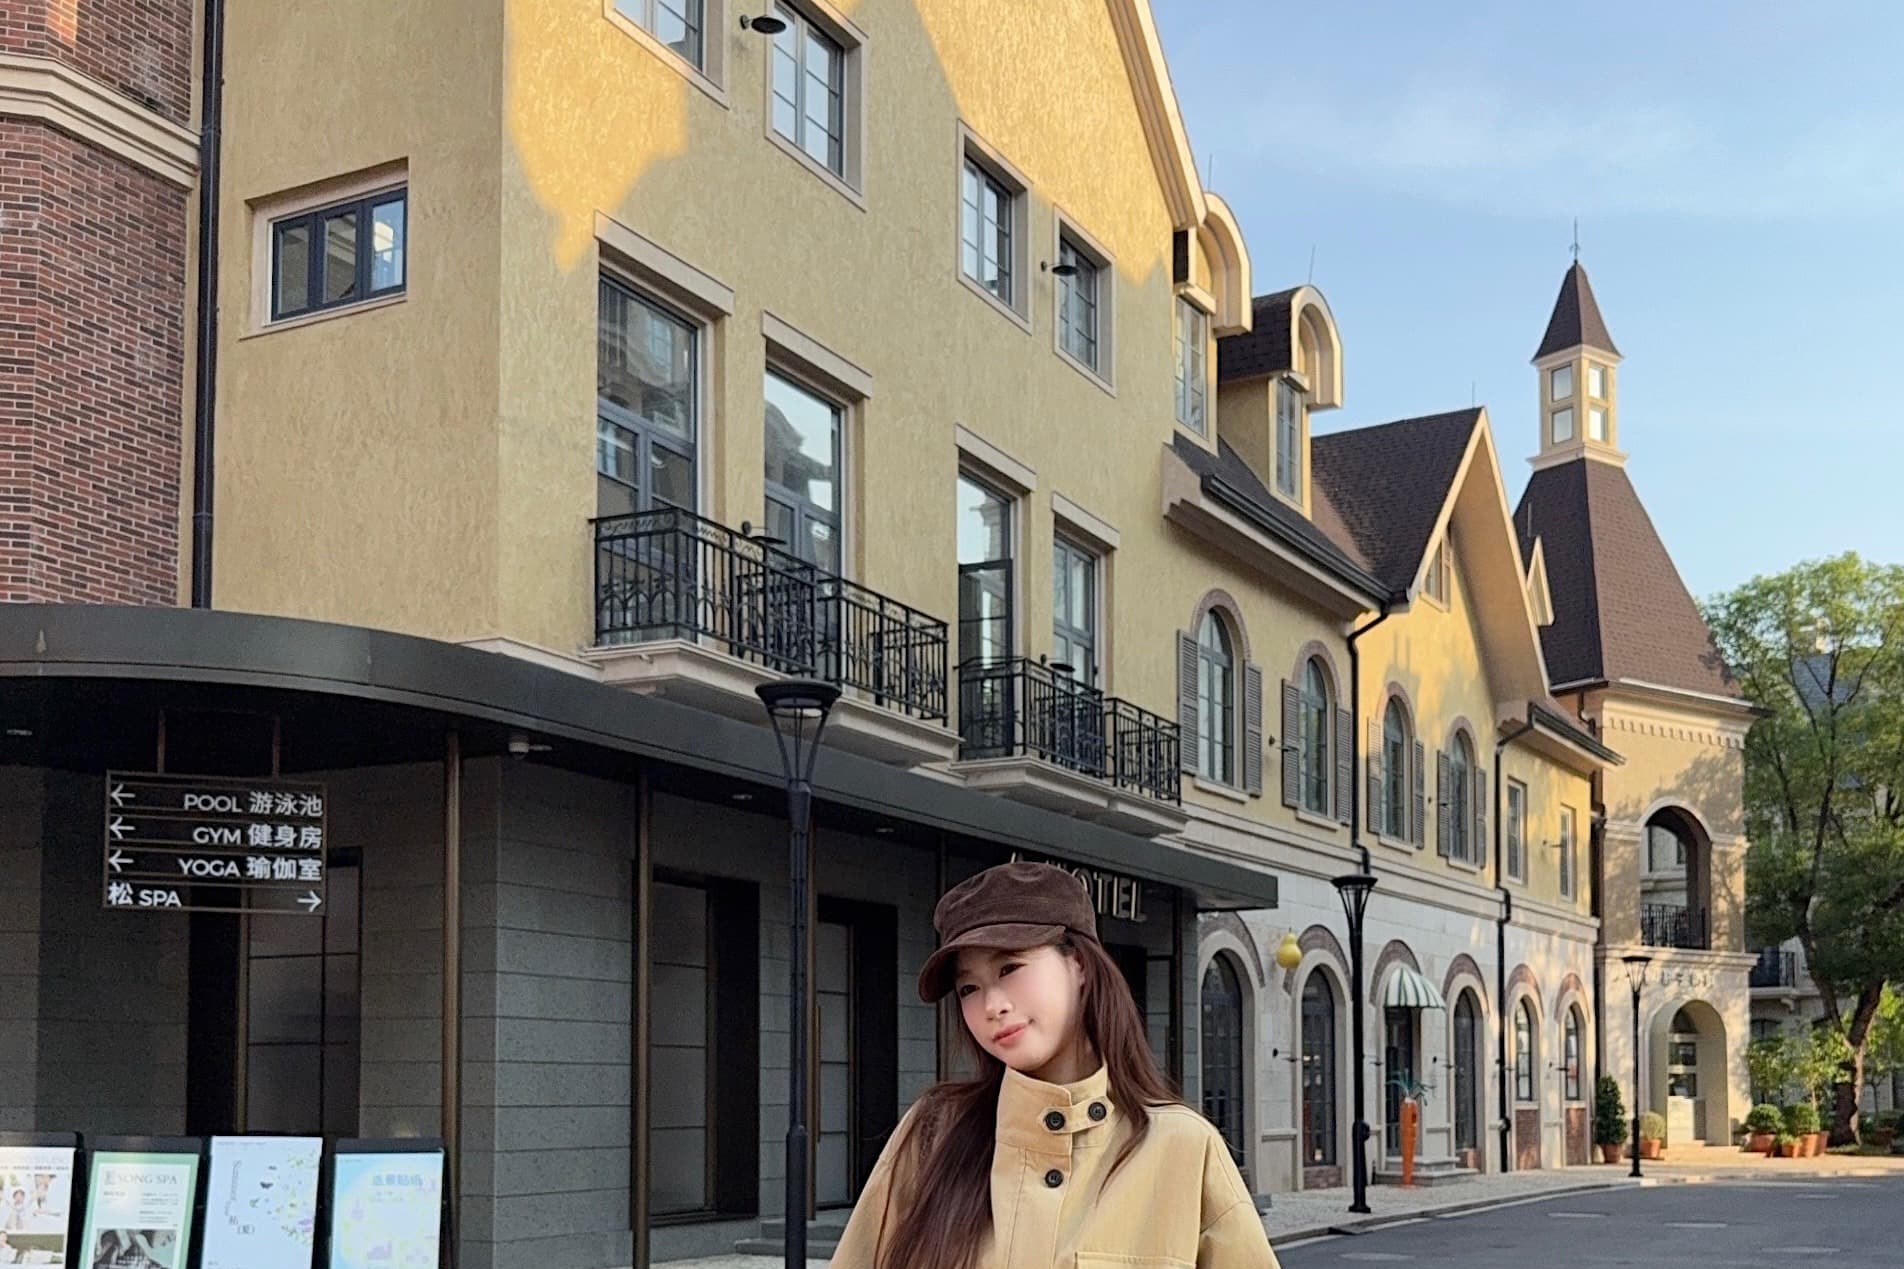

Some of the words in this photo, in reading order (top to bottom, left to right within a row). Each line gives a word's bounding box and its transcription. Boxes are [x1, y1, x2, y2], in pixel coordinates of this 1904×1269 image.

[183, 793, 242, 813] POOL
[249, 791, 323, 817] 游泳池
[193, 827, 241, 845] GYM
[248, 823, 322, 849] 健身房
[178, 858, 240, 877] YOGA
[246, 856, 322, 881] 瑜伽室
[108, 882, 134, 906] 松
[139, 890, 182, 908] SPA
[155, 1174, 177, 1185] SPA
